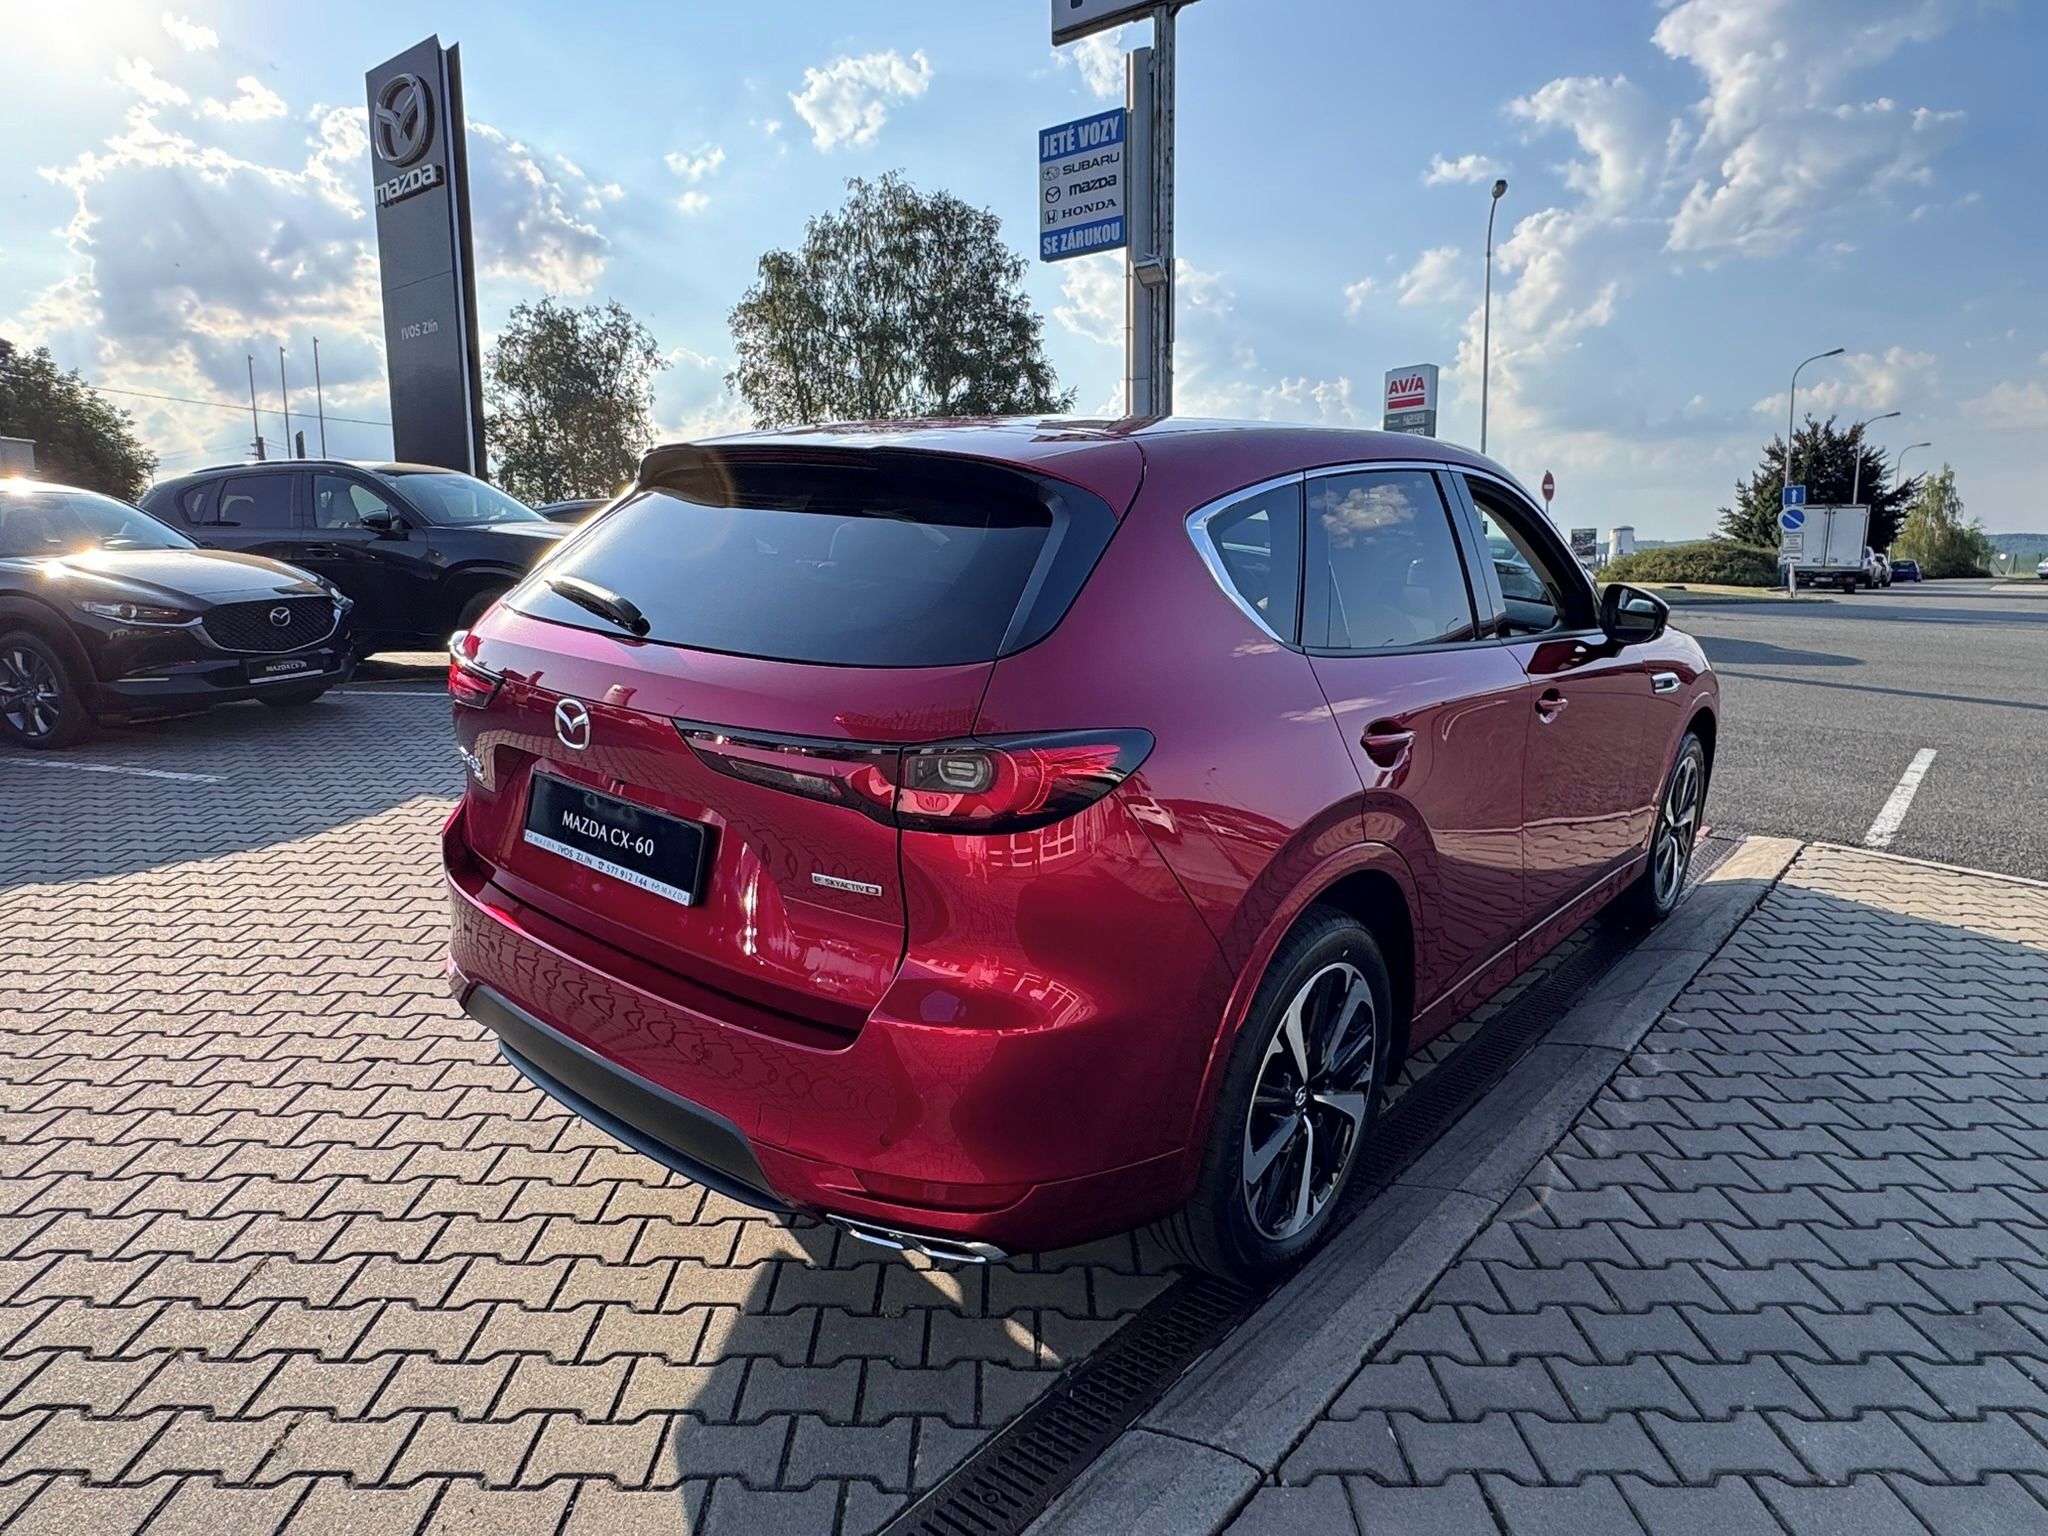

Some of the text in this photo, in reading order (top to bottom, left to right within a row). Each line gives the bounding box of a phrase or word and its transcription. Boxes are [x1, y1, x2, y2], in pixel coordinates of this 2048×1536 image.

[1042, 116, 1120, 158] JETÉ VOZY
[1062, 151, 1120, 175] SUBARU
[374, 162, 437, 205] mazda
[1069, 174, 1117, 196] mazda
[1061, 198, 1117, 219] HONDA
[1043, 222, 1120, 255] SE ZÁRUKOU
[562, 810, 655, 857] MAZDA CX-60
